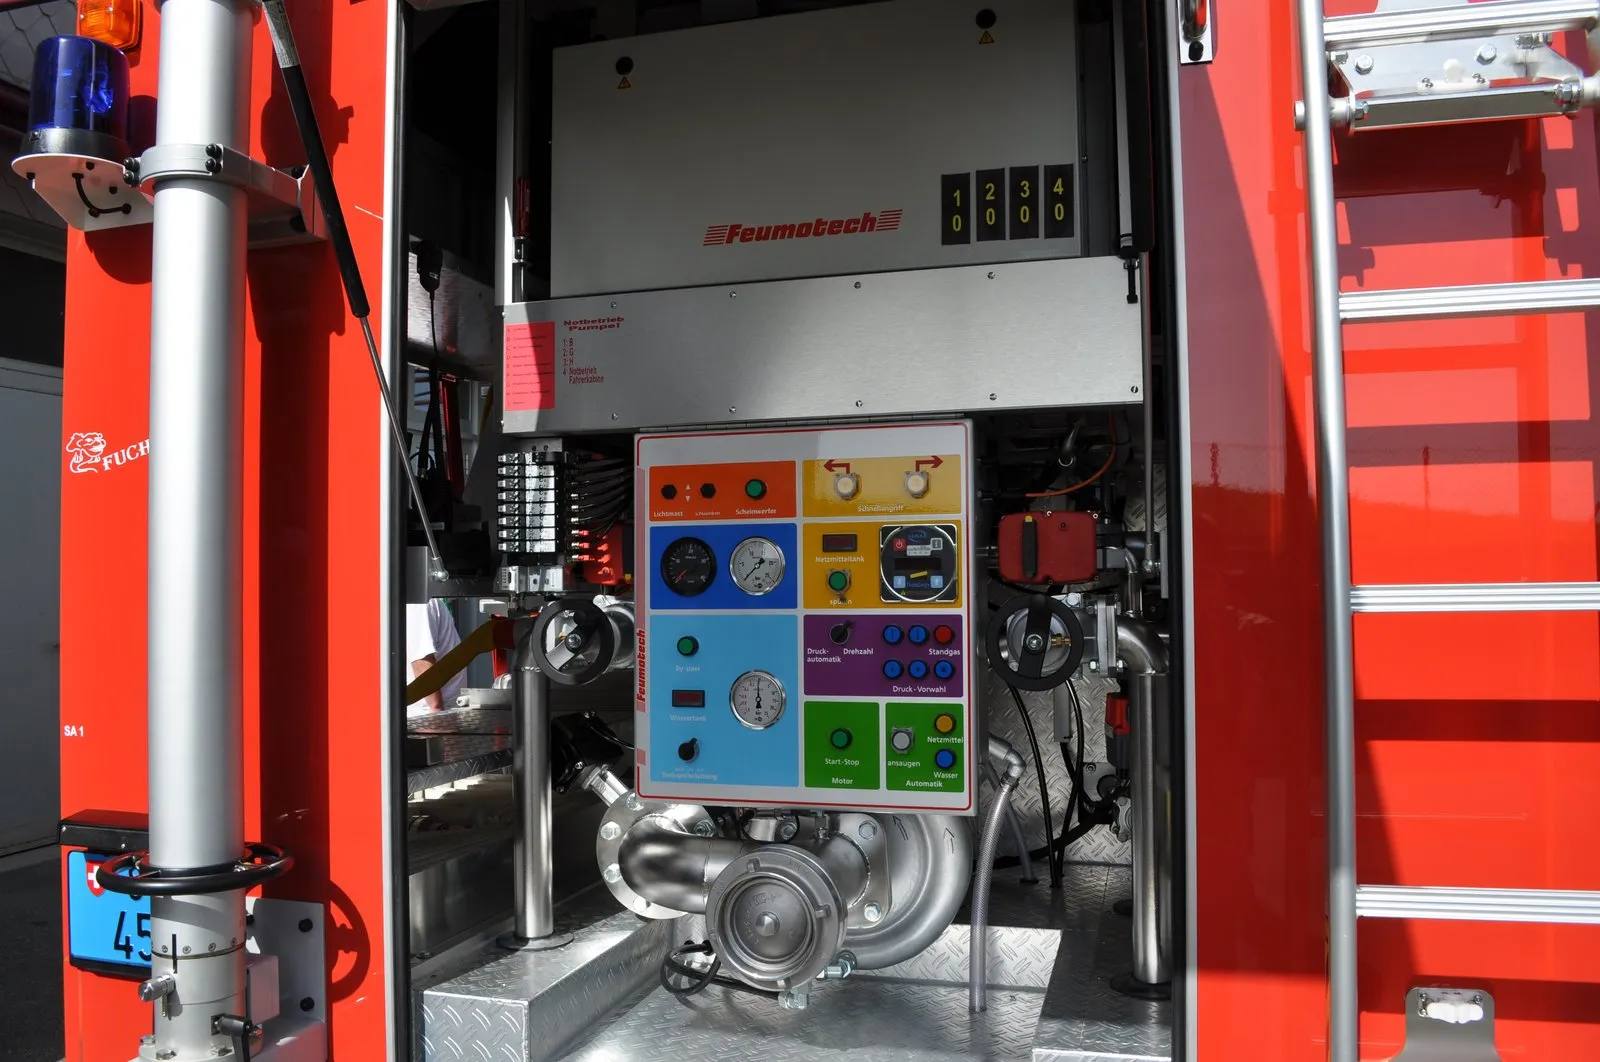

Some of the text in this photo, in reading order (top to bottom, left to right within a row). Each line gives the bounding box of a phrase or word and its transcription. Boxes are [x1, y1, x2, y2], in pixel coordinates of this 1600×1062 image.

[986, 184, 994, 200] 2
[1020, 181, 1030, 198] 3
[1054, 178, 1064, 195] 4
[954, 190, 960, 207] 1
[986, 208, 996, 225] 0
[1020, 206, 1030, 223] 0
[1055, 204, 1064, 220] 0
[725, 211, 877, 244] Feumotech
[952, 215, 962, 232] 0
[563, 316, 624, 326] Notbetrieb
[569, 338, 574, 346] B
[569, 348, 574, 356] G
[569, 366, 597, 376] Notbetrieb
[569, 374, 604, 384] Fahrerkabine
[857, 504, 904, 513] Schnellangriff
[928, 648, 960, 656] Standgas
[637, 629, 646, 702] Feumotech
[64, 725, 84, 737] SA 1
[927, 736, 964, 744] Netzmittel
